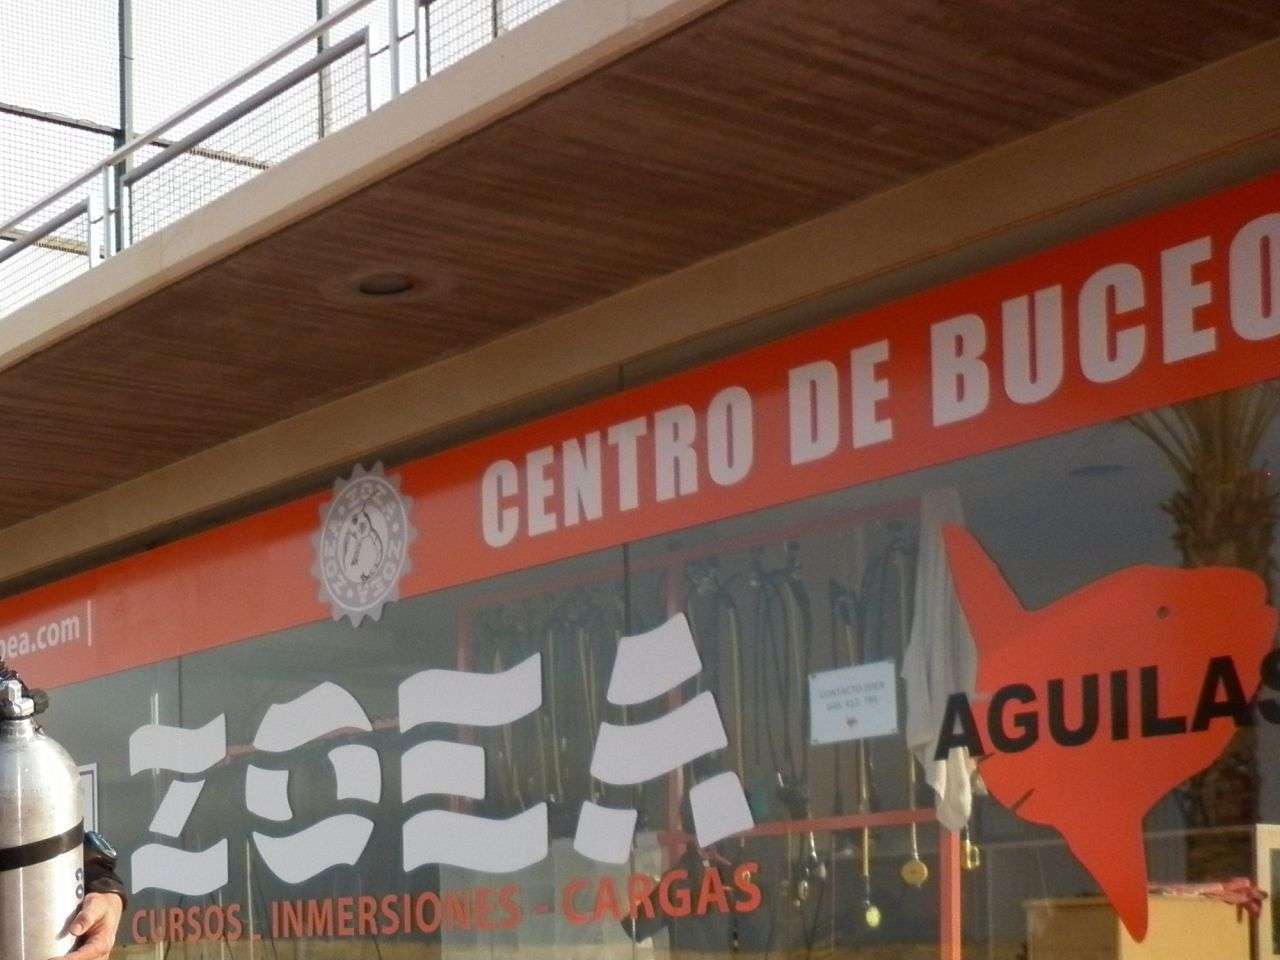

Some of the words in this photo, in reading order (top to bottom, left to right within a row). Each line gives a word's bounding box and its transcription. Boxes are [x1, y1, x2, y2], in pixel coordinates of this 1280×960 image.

[480, 385, 754, 549] CENTRO
[788, 339, 895, 466] DE
[929, 211, 1280, 427] BUCEO
[129, 611, 755, 896] ZOEA
[131, 903, 243, 945] CURSOS
[271, 884, 522, 938] INMERSIONES
[561, 862, 762, 926] CARGAS
